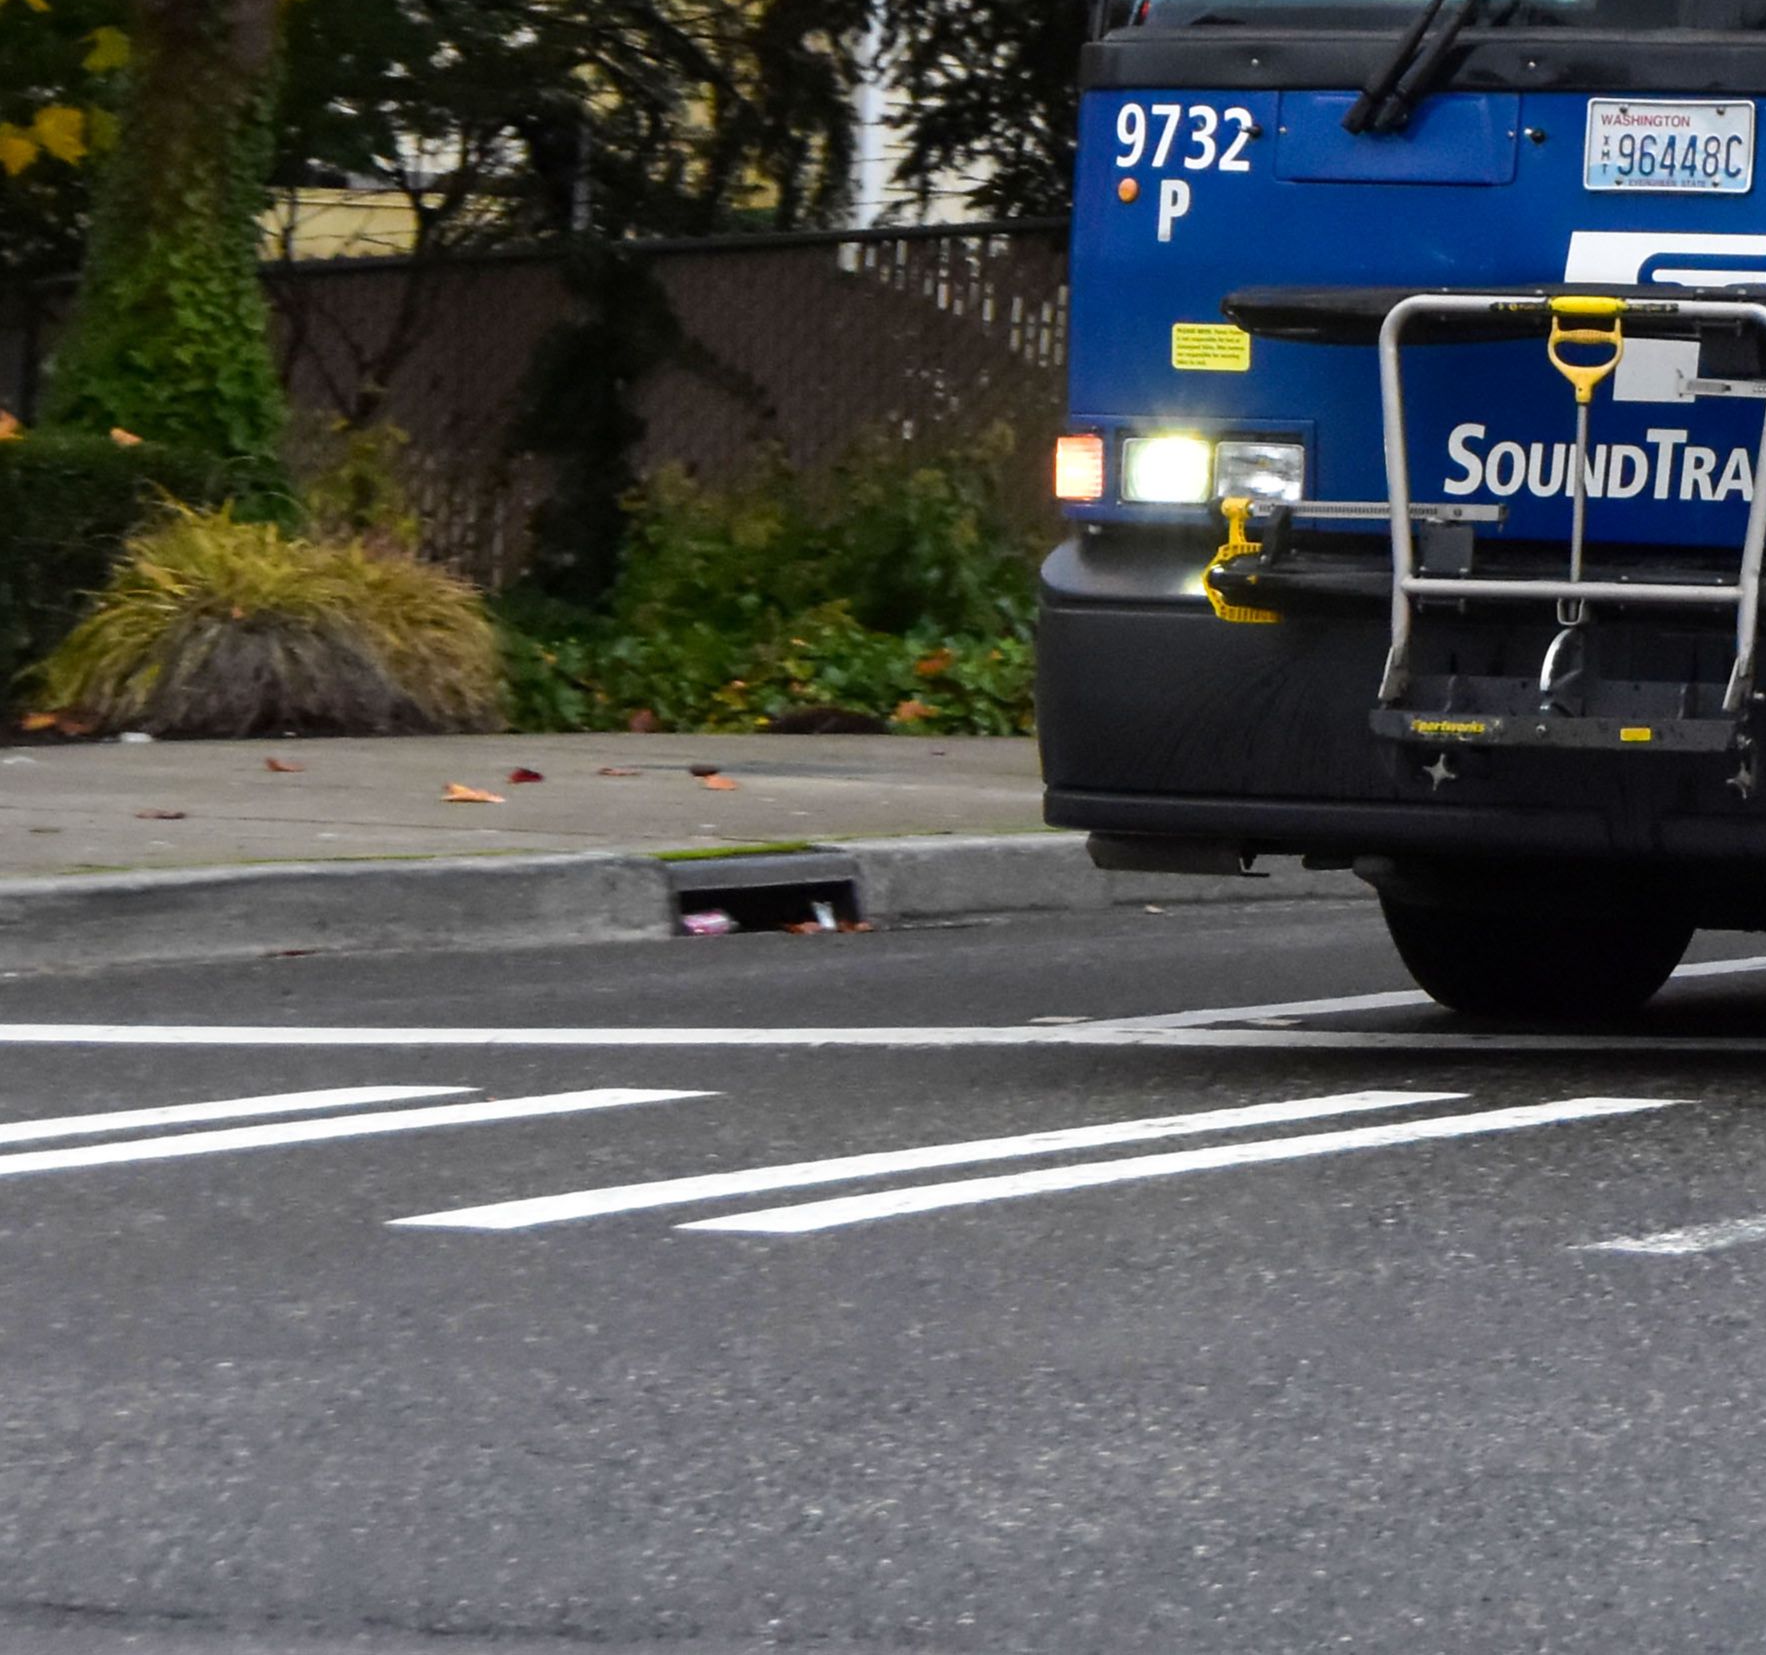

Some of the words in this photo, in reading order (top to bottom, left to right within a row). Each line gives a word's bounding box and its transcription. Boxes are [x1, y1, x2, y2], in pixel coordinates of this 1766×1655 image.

[1116, 103, 1251, 171] 9732
[1601, 115, 1690, 127] WASHINGTON
[1617, 133, 1743, 178] 96448C
[1157, 179, 1190, 242] P
